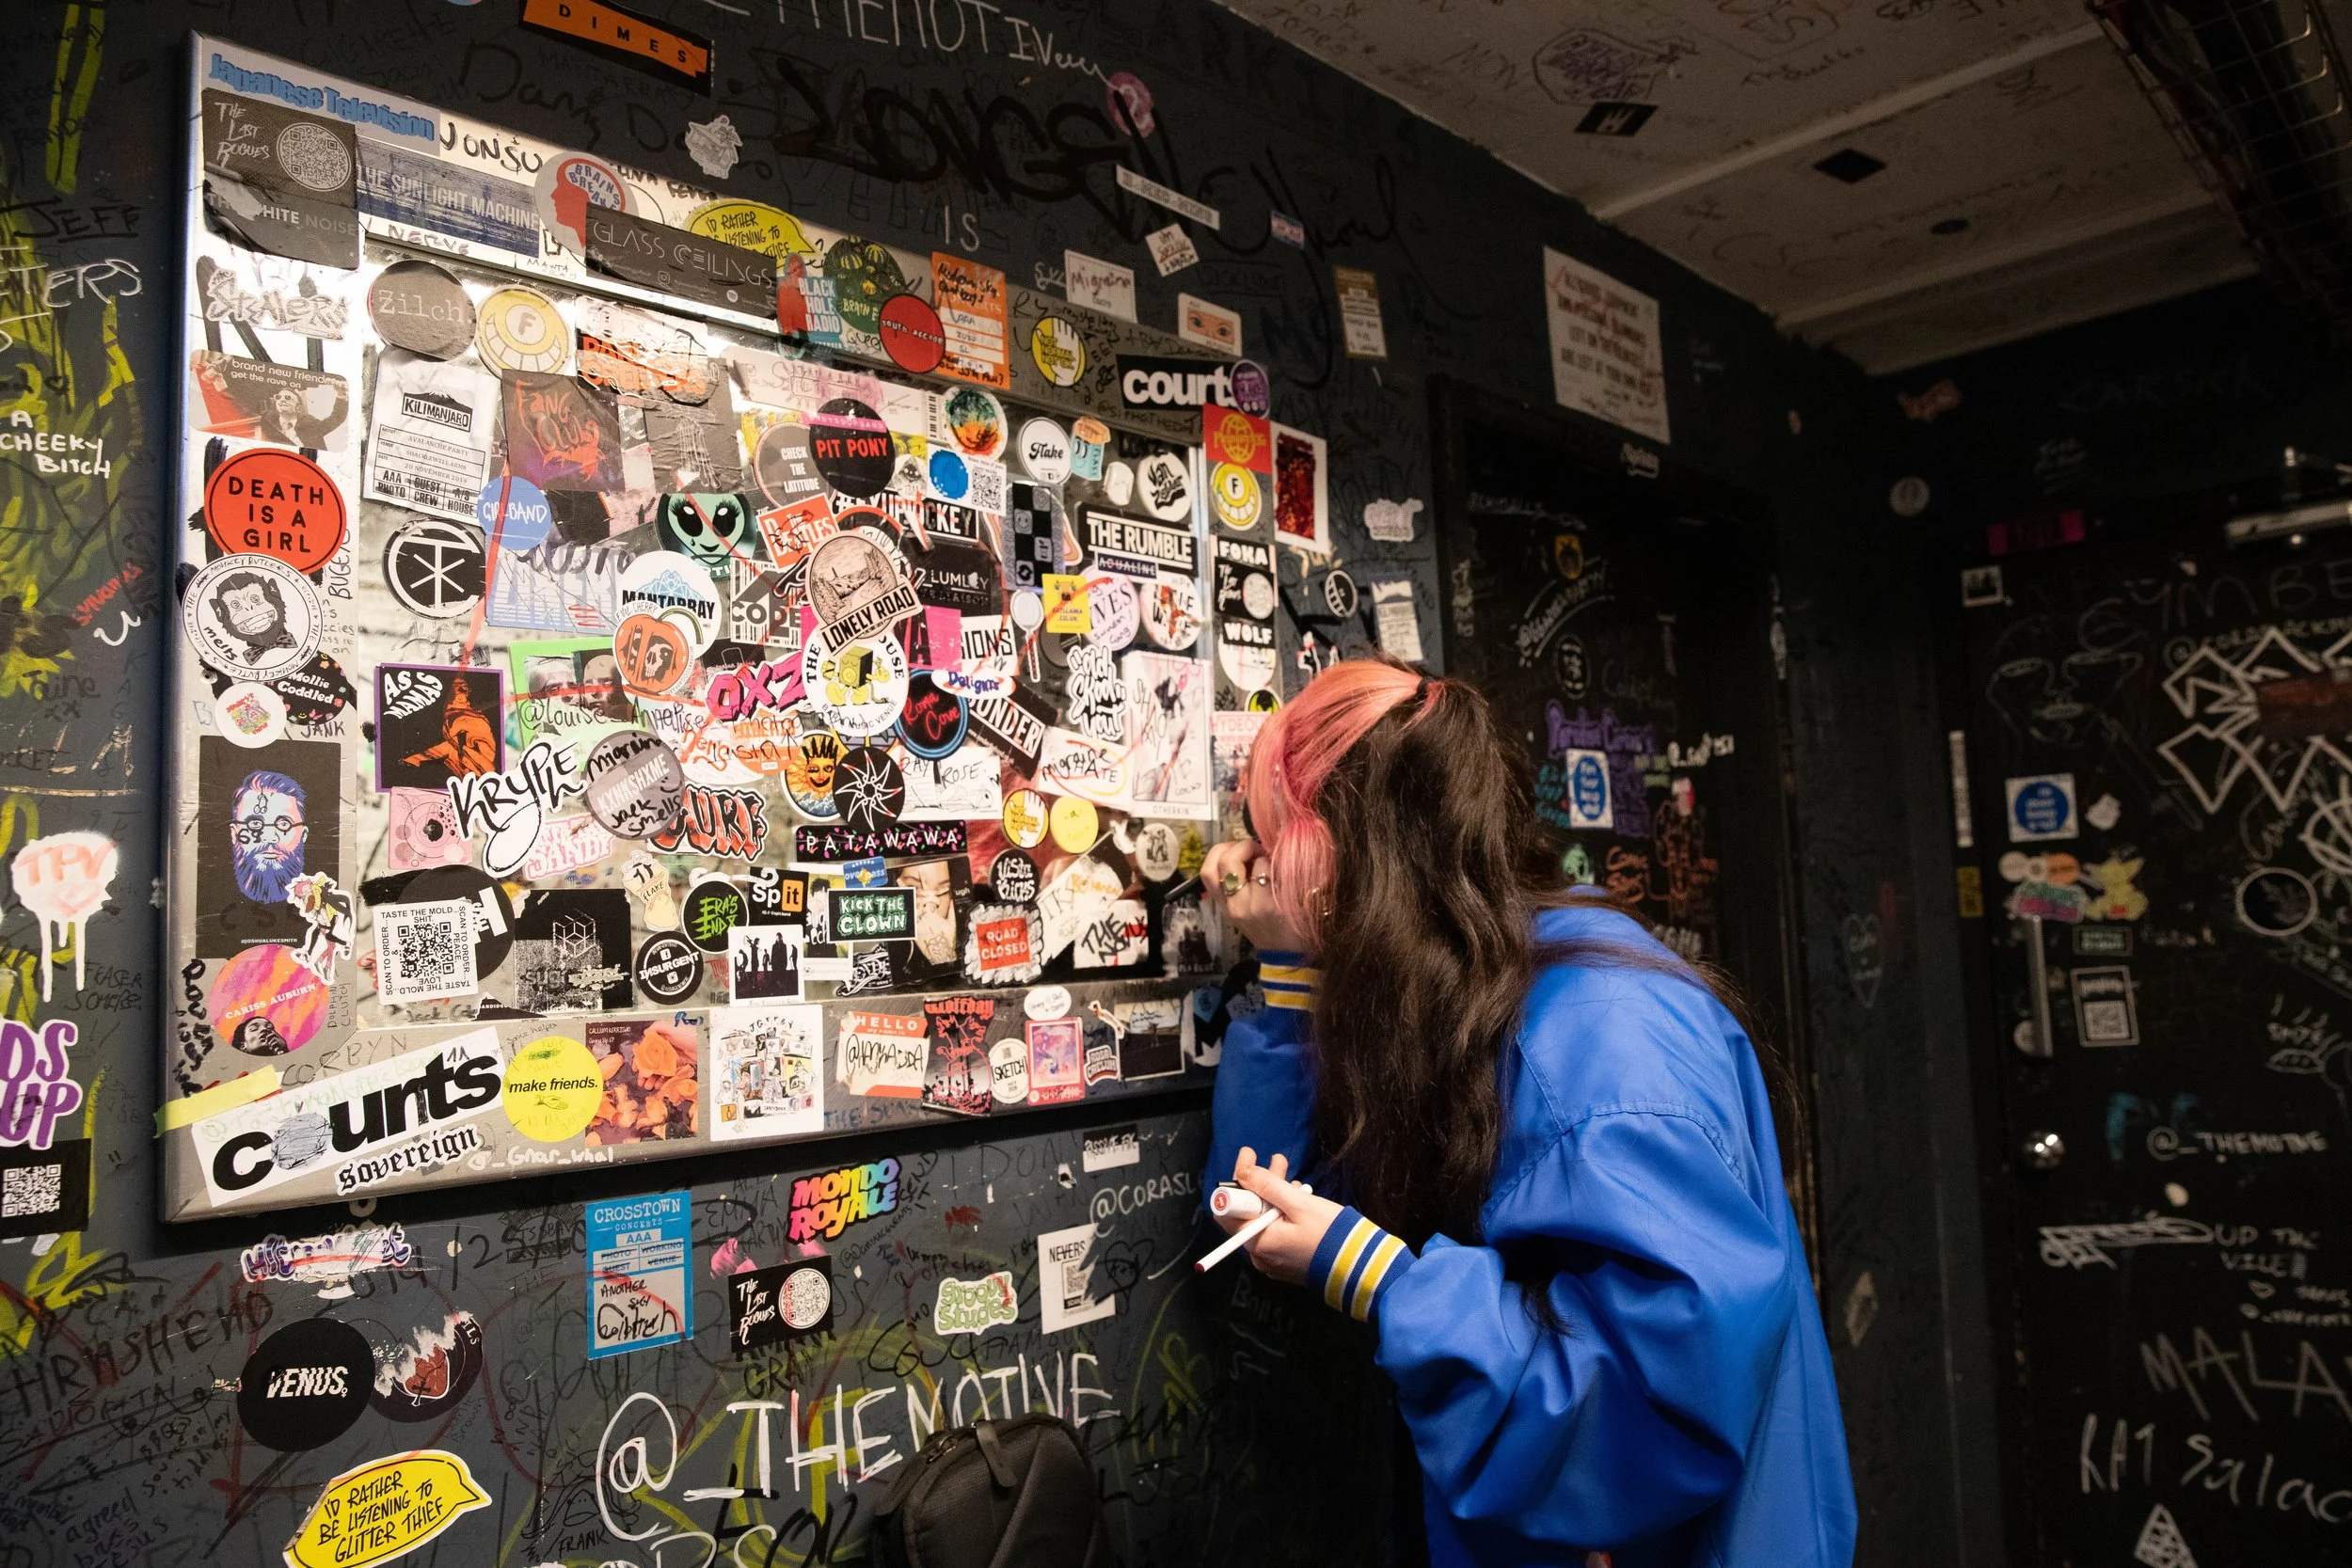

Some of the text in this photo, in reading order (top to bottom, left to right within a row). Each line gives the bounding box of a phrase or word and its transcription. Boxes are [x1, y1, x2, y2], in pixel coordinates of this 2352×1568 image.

[559, 2, 688, 64] DIMES
[209, 53, 436, 142] Japanese Television
[470, 195, 539, 232] MACHINE
[721, 211, 758, 230] RATHER
[594, 221, 665, 259] GLASS
[799, 277, 834, 297] BLACK
[806, 298, 834, 314] HOLE
[805, 314, 839, 333] RADIO
[230, 371, 301, 388] get the rave on
[231, 358, 293, 379] brand new
[408, 436, 469, 456] AVALANCHE PARTY
[781, 446, 808, 461] CHECK
[816, 437, 887, 459] PIT PONY
[383, 470, 402, 483] AAA
[415, 466, 451, 480] NOVEMBER
[789, 463, 805, 476] THE
[228, 476, 325, 506] DEATH
[784, 477, 819, 494] LATITUDE
[249, 505, 308, 528] IS A
[507, 502, 547, 524] BAND
[243, 529, 311, 554] GIRL
[1088, 518, 1192, 563] THE RUMBLE
[822, 609, 870, 650] LONELY
[873, 586, 916, 620] ROAD
[1224, 622, 1272, 644] WOLF
[806, 643, 821, 684] THE
[289, 672, 330, 690] Mollie
[278, 682, 335, 705] Coddled
[383, 672, 444, 720] MAMAS
[806, 830, 959, 851] PATAWAWA
[381, 910, 407, 919] TASTE
[409, 908, 426, 917] THE
[840, 895, 905, 913] KICK THE
[460, 923, 467, 932] TO
[838, 912, 906, 935] CLOWN
[987, 927, 1018, 943] ROAD
[981, 941, 1029, 960] CLOSED
[384, 961, 392, 973] TO
[426, 981, 443, 990] THE
[445, 978, 471, 989] TASTE
[225, 983, 318, 1020] CARISS AUBURN
[855, 1015, 918, 1031] HELLO
[994, 1058, 1025, 1082] SKETCH
[509, 1075, 598, 1094] make friends.
[339, 1127, 477, 1192] sovereign
[792, 1158, 900, 1208] MONDO
[594, 1196, 681, 1224] CROSSTOWN
[789, 1181, 899, 1243] ROYALE
[614, 1217, 662, 1231] CONCERTS
[627, 1232, 652, 1243] AAA
[747, 1291, 770, 1315] LAST
[739, 1307, 775, 1344] ROGUES
[324, 1470, 404, 1520] I'D RATHER
[319, 1478, 434, 1546] BE LISTENING TO
[335, 1497, 444, 1563] GLITTER THIEF
